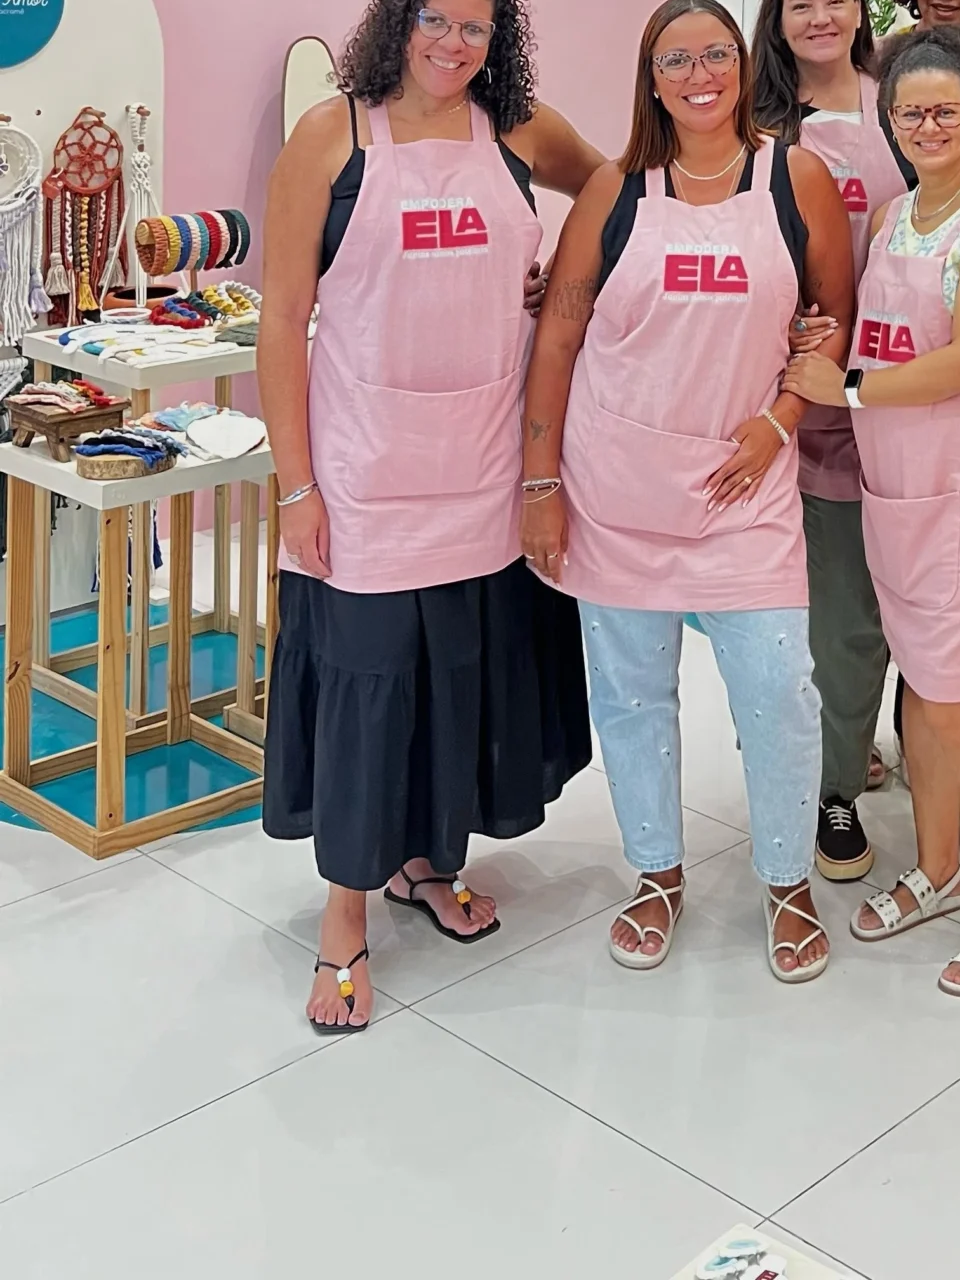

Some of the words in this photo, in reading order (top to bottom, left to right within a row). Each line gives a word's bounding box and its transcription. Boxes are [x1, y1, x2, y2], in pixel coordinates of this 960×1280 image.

[402, 207, 489, 251] ELA
[663, 254, 749, 294] ELA
[858, 319, 917, 363] ELA
